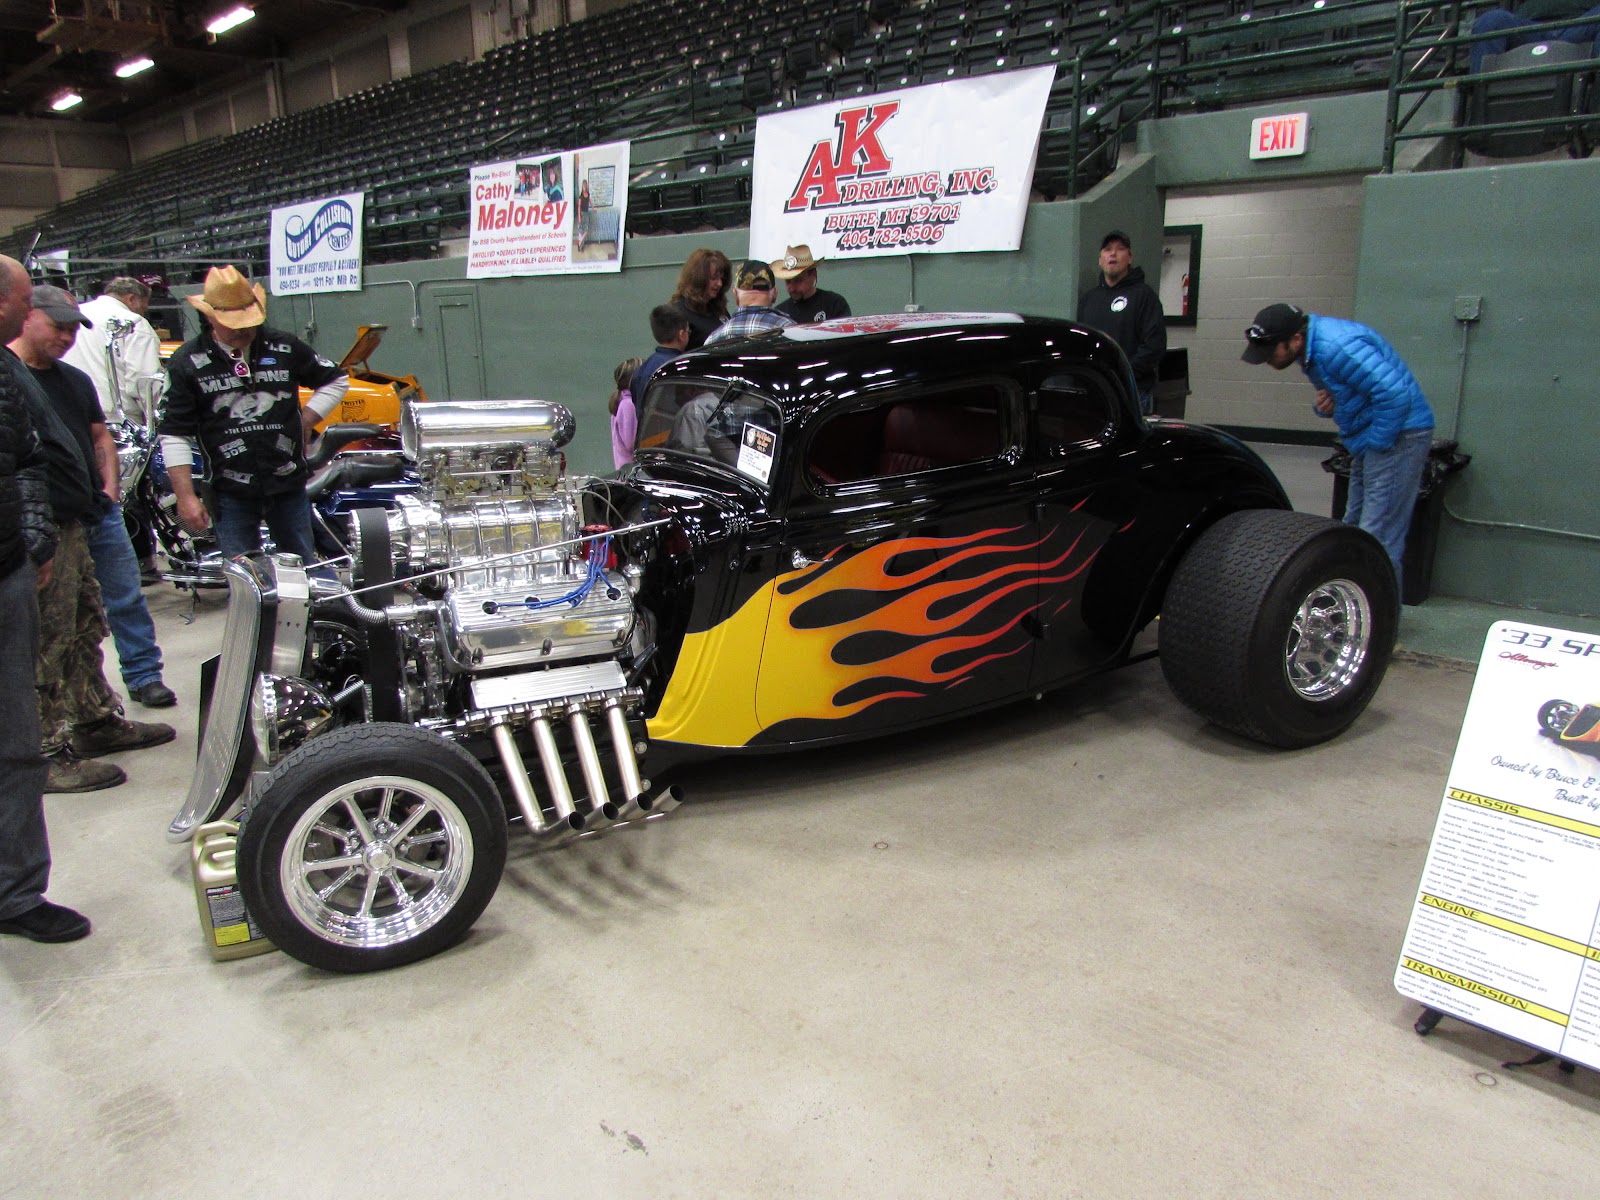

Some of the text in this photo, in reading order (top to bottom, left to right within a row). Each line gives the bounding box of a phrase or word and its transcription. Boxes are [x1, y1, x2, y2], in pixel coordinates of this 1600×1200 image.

[1259, 118, 1300, 152] EXIT
[783, 99, 900, 213] AK
[476, 182, 512, 201] Cathy
[843, 167, 998, 204] DRILLING, INC.
[314, 204, 352, 241] COLLISION
[477, 201, 568, 231] Maloney
[822, 202, 962, 234] BUTTE, MT 59701
[530, 246, 566, 254] EXPERIENCED
[837, 222, 946, 251] 406-782-8506
[538, 255, 566, 264] QUALIFIED
[200, 370, 290, 394] MUSANG
[1490, 755, 1530, 773] Owned
[1529, 765, 1542, 778] by
[1545, 768, 1579, 786] Bruce
[1450, 790, 1520, 814] CHASSIS
[1422, 895, 1480, 920] ENGINE
[1405, 958, 1529, 1010] TRANSMISSION
